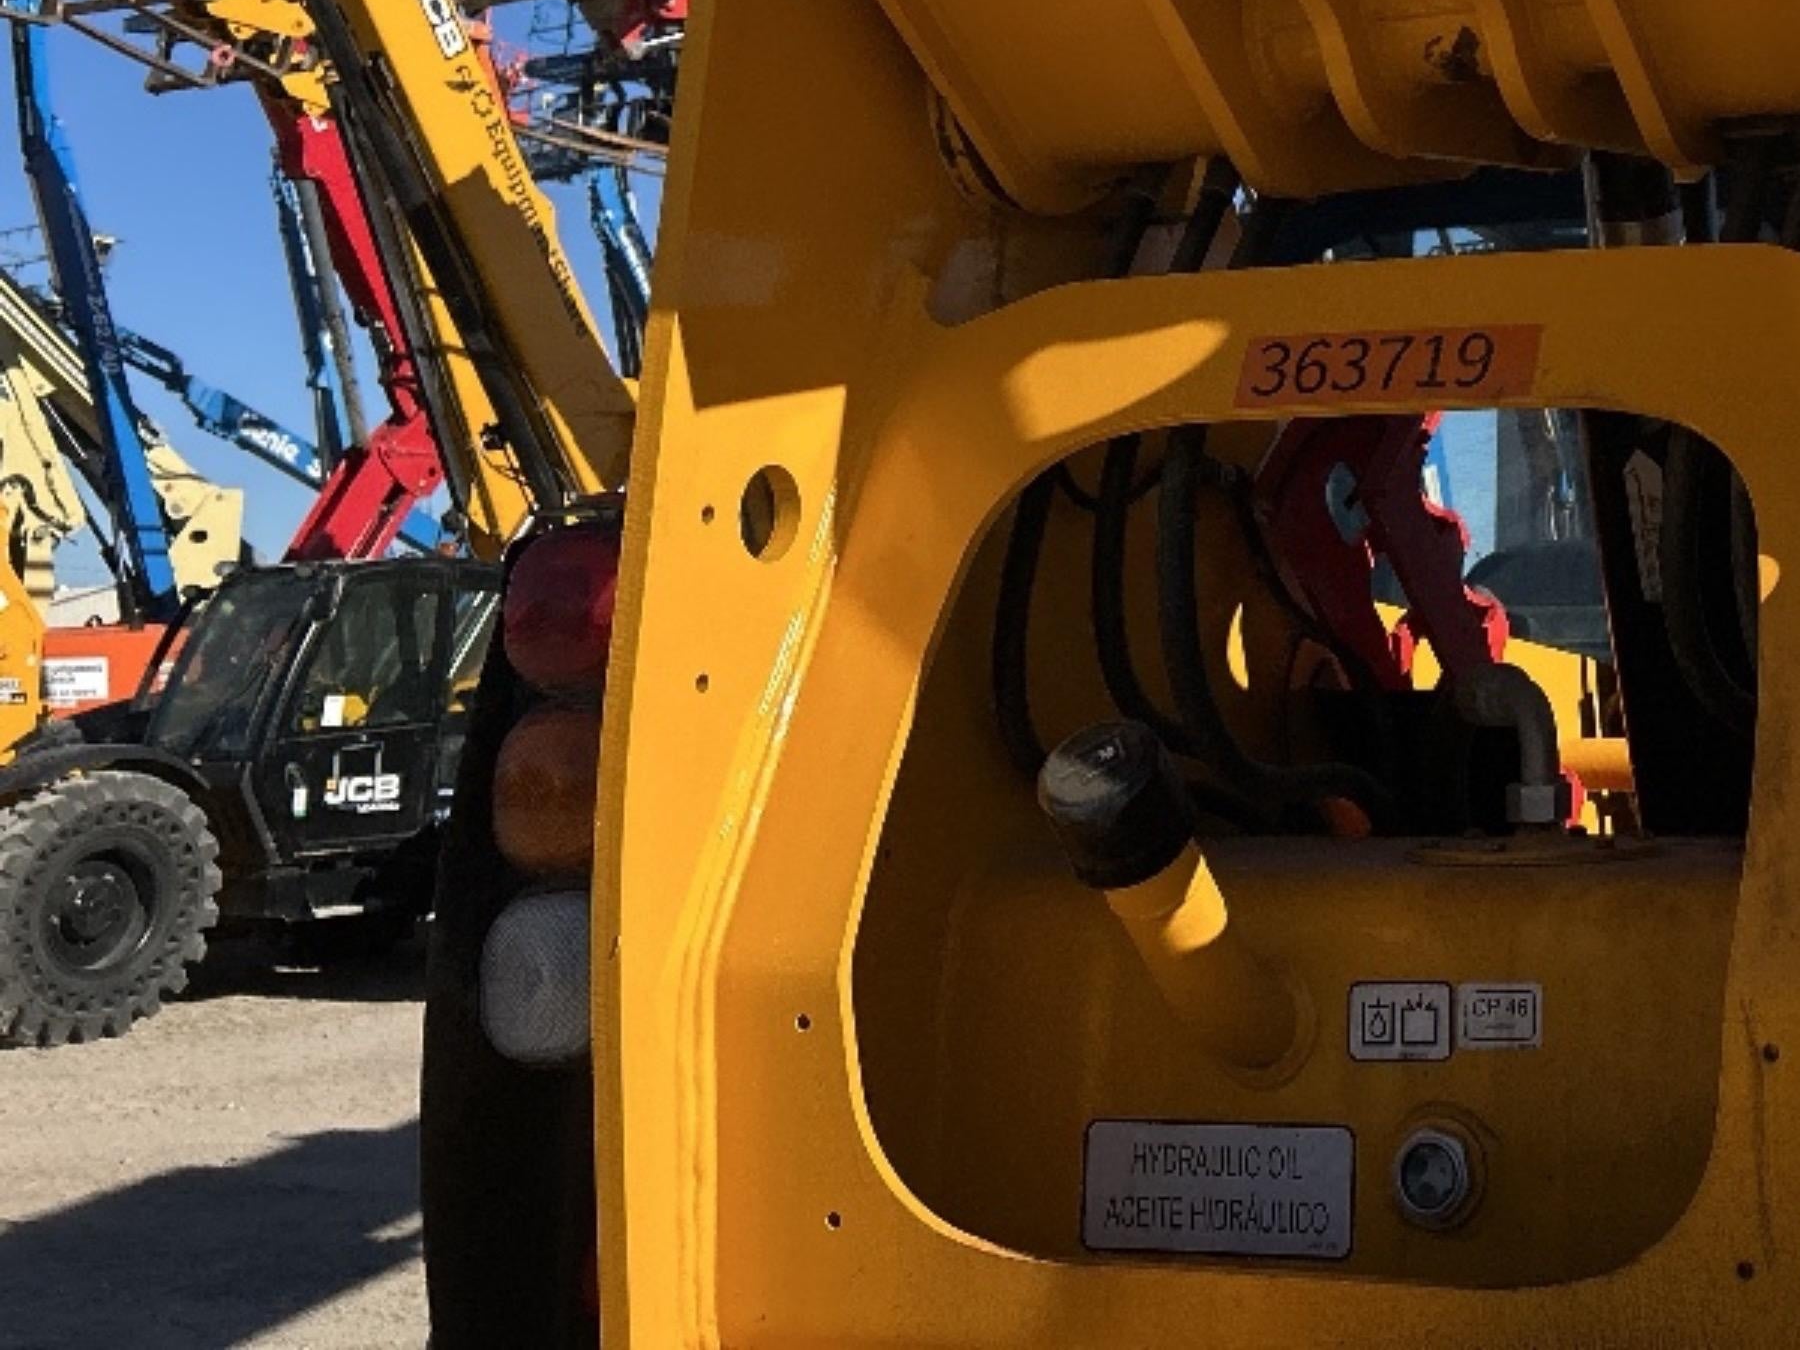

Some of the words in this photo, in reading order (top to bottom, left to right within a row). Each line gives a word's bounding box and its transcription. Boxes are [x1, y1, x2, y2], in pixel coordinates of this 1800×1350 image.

[1251, 331, 1496, 397] 363719
[323, 774, 400, 806] JCB
[1130, 1142, 1261, 1179] HYDRAULIC
[1267, 1144, 1303, 1180] OIL
[1103, 1195, 1183, 1229] ACEITE
[1189, 1192, 1331, 1236] HIDRÁULICO
